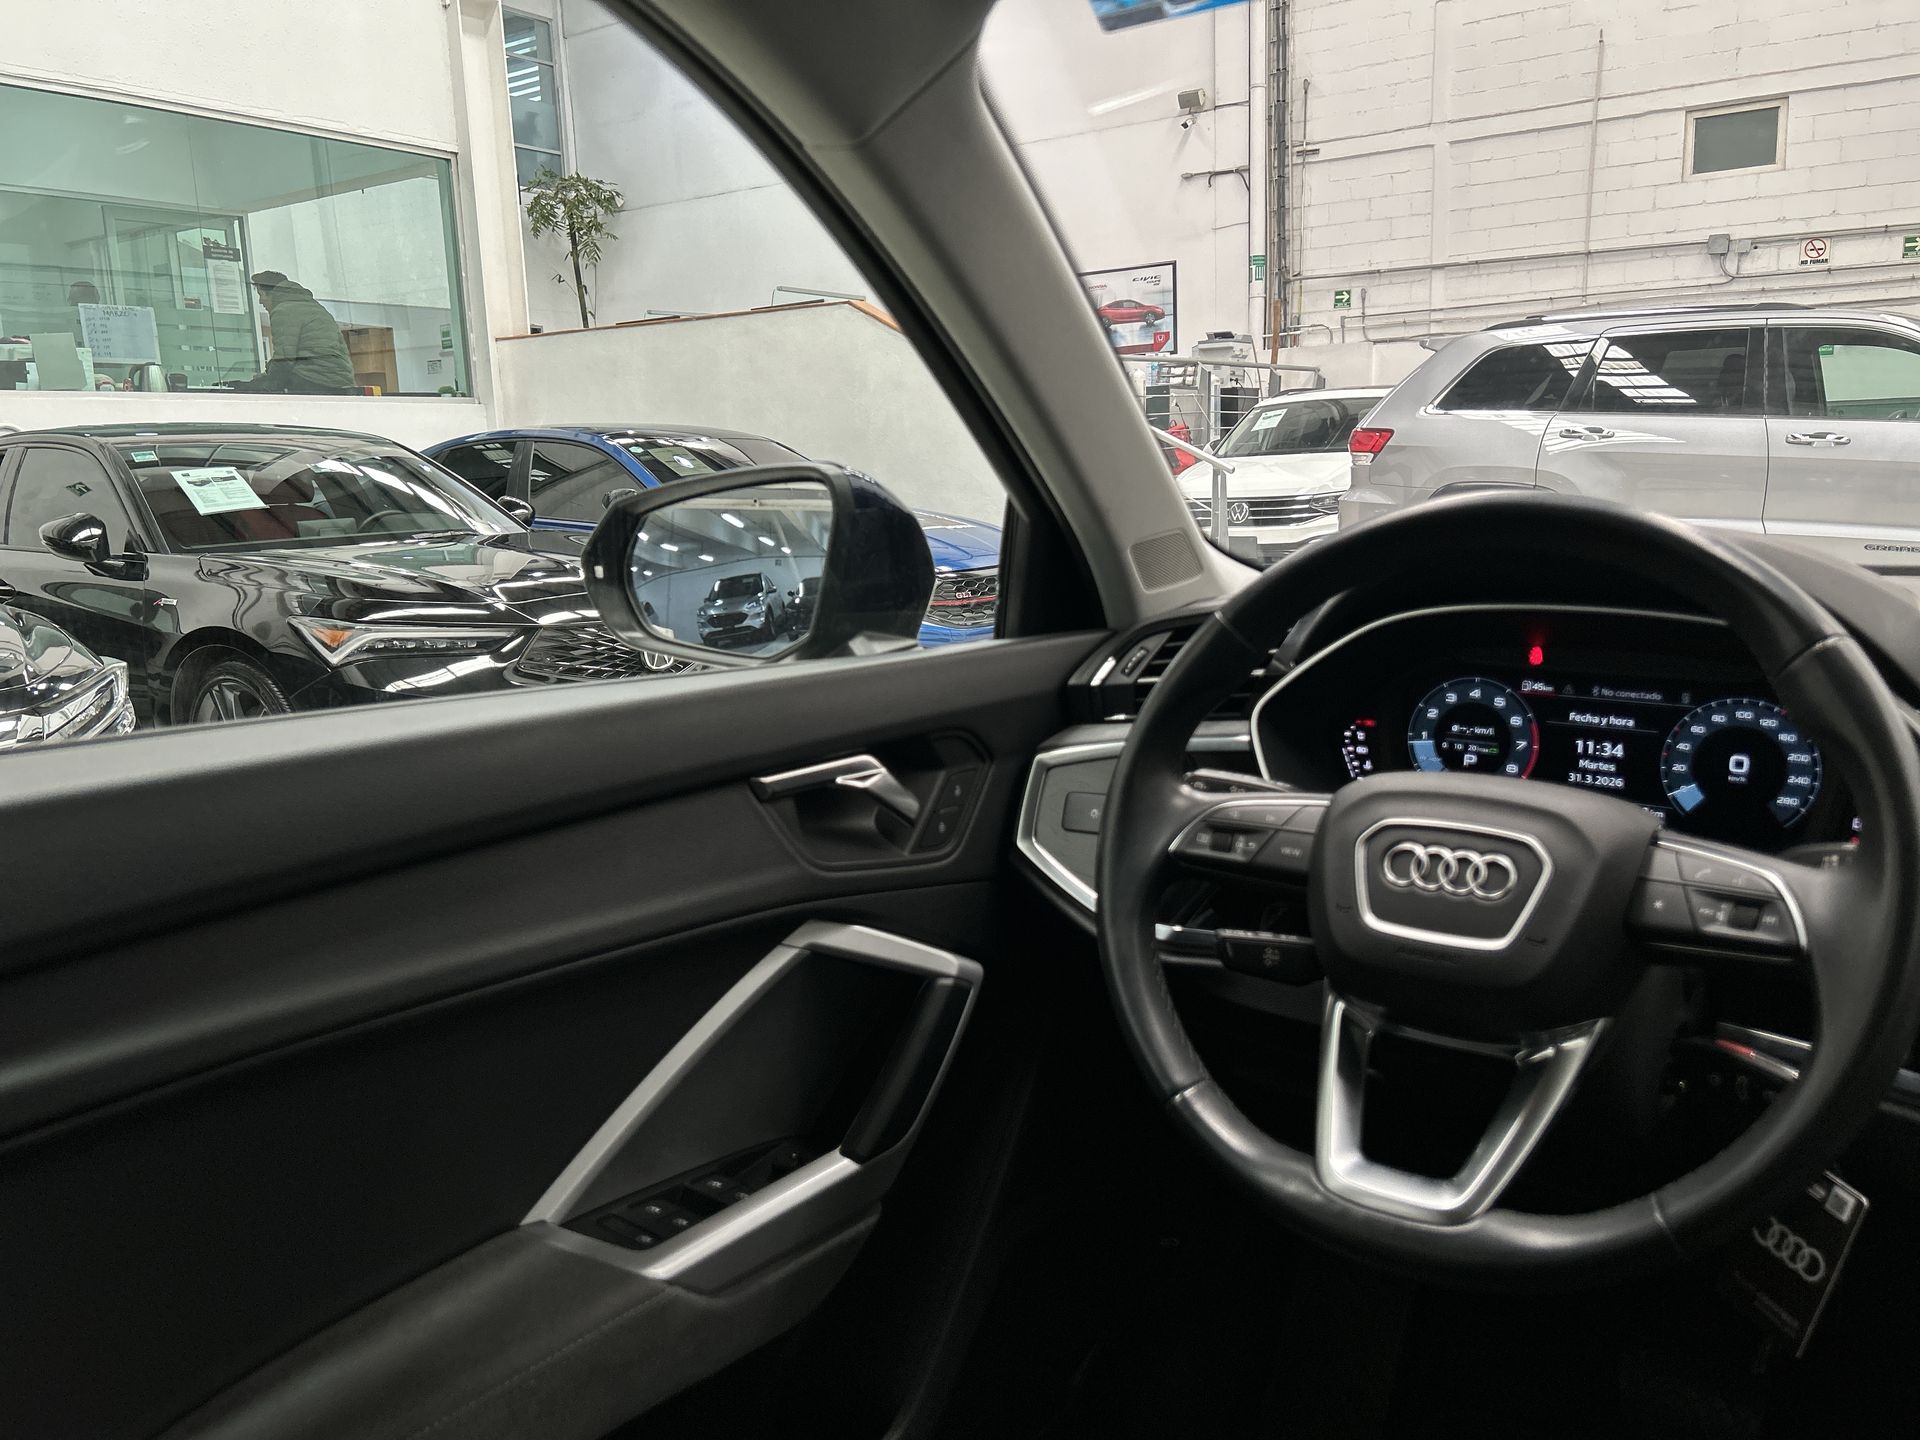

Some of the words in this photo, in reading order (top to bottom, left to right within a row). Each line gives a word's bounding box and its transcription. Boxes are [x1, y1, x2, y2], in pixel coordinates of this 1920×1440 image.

[1132, 274, 1161, 282] CIVIC
[955, 591, 972, 599] GLI
[1445, 693, 1458, 703] 3
[1469, 689, 1481, 698] 4
[1601, 688, 1614, 697] No
[1615, 690, 1662, 700] conectado
[1494, 697, 1506, 707] 5
[1427, 708, 1439, 718] 2
[1735, 710, 1754, 719] 100
[1510, 716, 1523, 726] 6
[1568, 711, 1600, 724] Fecha
[1600, 717, 1608, 726] y
[1608, 715, 1636, 727] hora
[1759, 718, 1778, 727] 120
[1690, 725, 1706, 734] 60
[1421, 731, 1428, 740] 1
[1515, 740, 1529, 751] 7
[1575, 739, 1625, 758] 11:34
[1676, 743, 1692, 751] 40
[1463, 753, 1478, 766] P
[1787, 752, 1811, 762] 200
[1506, 763, 1519, 774] 8
[1578, 759, 1617, 772] Martes
[1671, 763, 1687, 772] 20
[1728, 754, 1750, 773] 0
[1567, 772, 1625, 787] 31.3.2026
[1787, 775, 1811, 785] 240
[1280, 846, 1303, 856] VIEW
